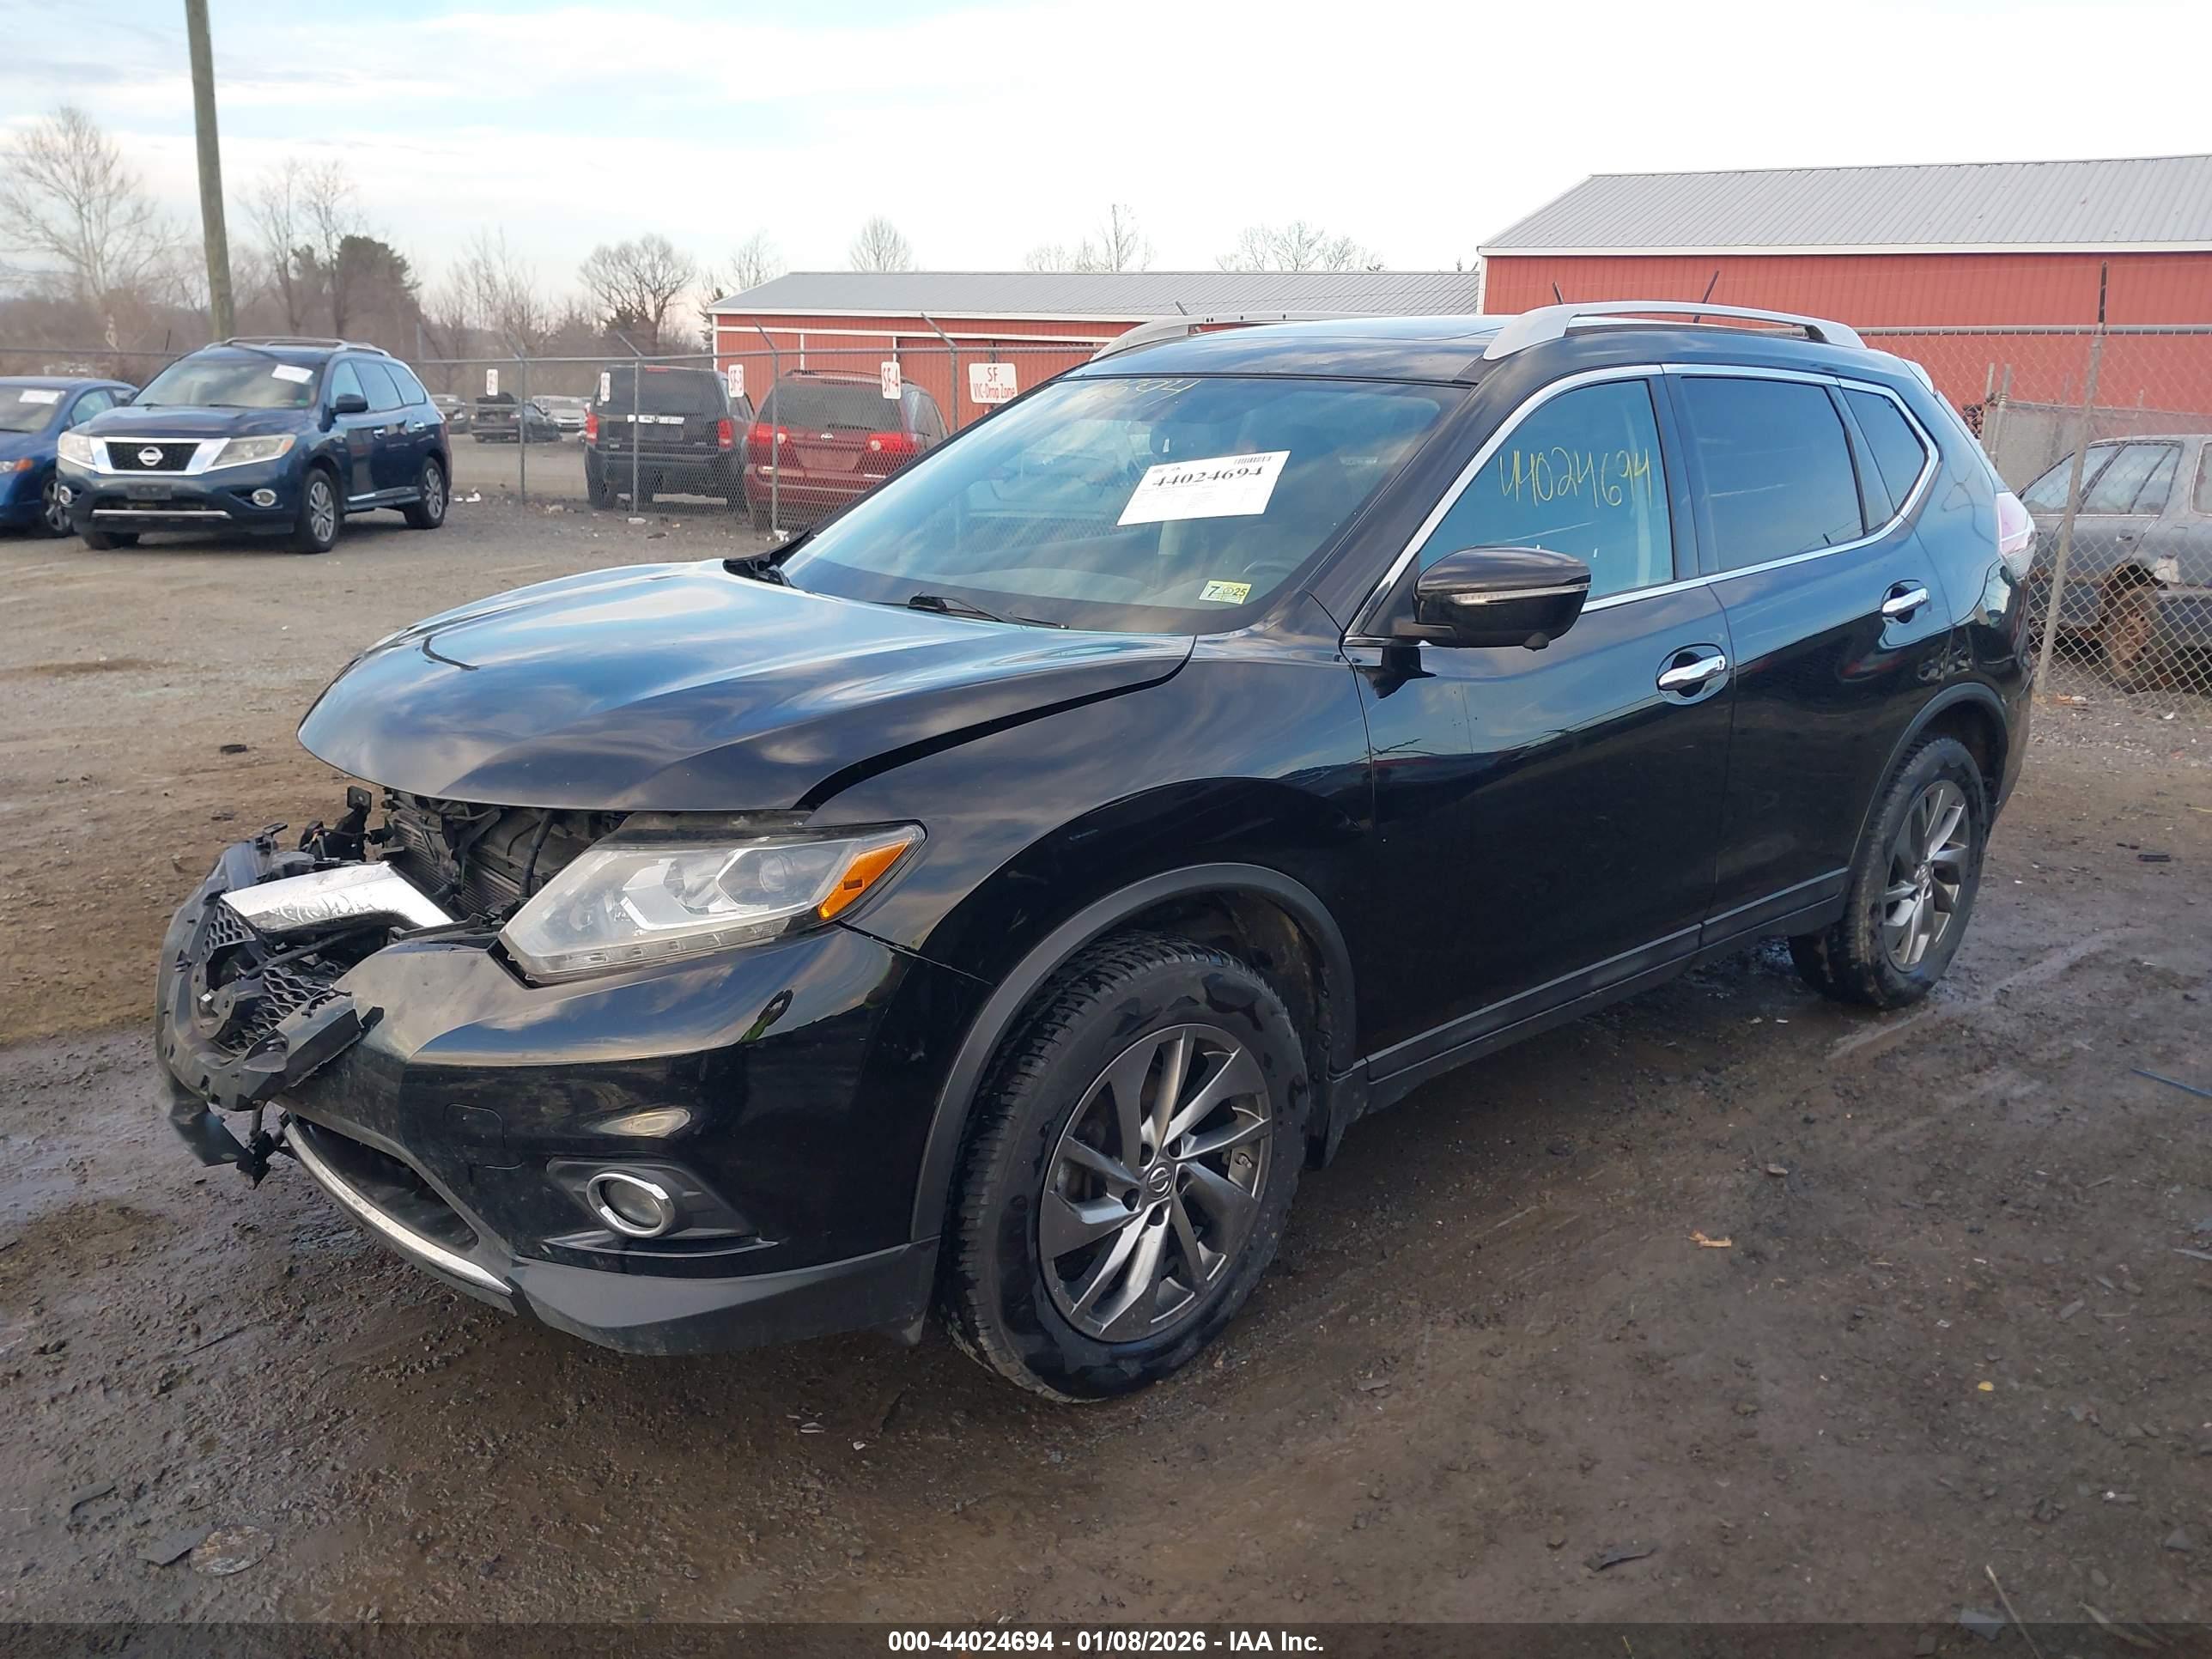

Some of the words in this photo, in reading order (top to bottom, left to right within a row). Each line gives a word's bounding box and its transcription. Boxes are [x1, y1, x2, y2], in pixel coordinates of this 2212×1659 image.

[988, 367, 998, 382] SF
[1000, 383, 1015, 398] Zone
[1152, 465, 1263, 486] 44024694
[1499, 447, 1652, 508] 44024694
[1208, 586, 1220, 597] 7
[1232, 587, 1248, 597] 25
